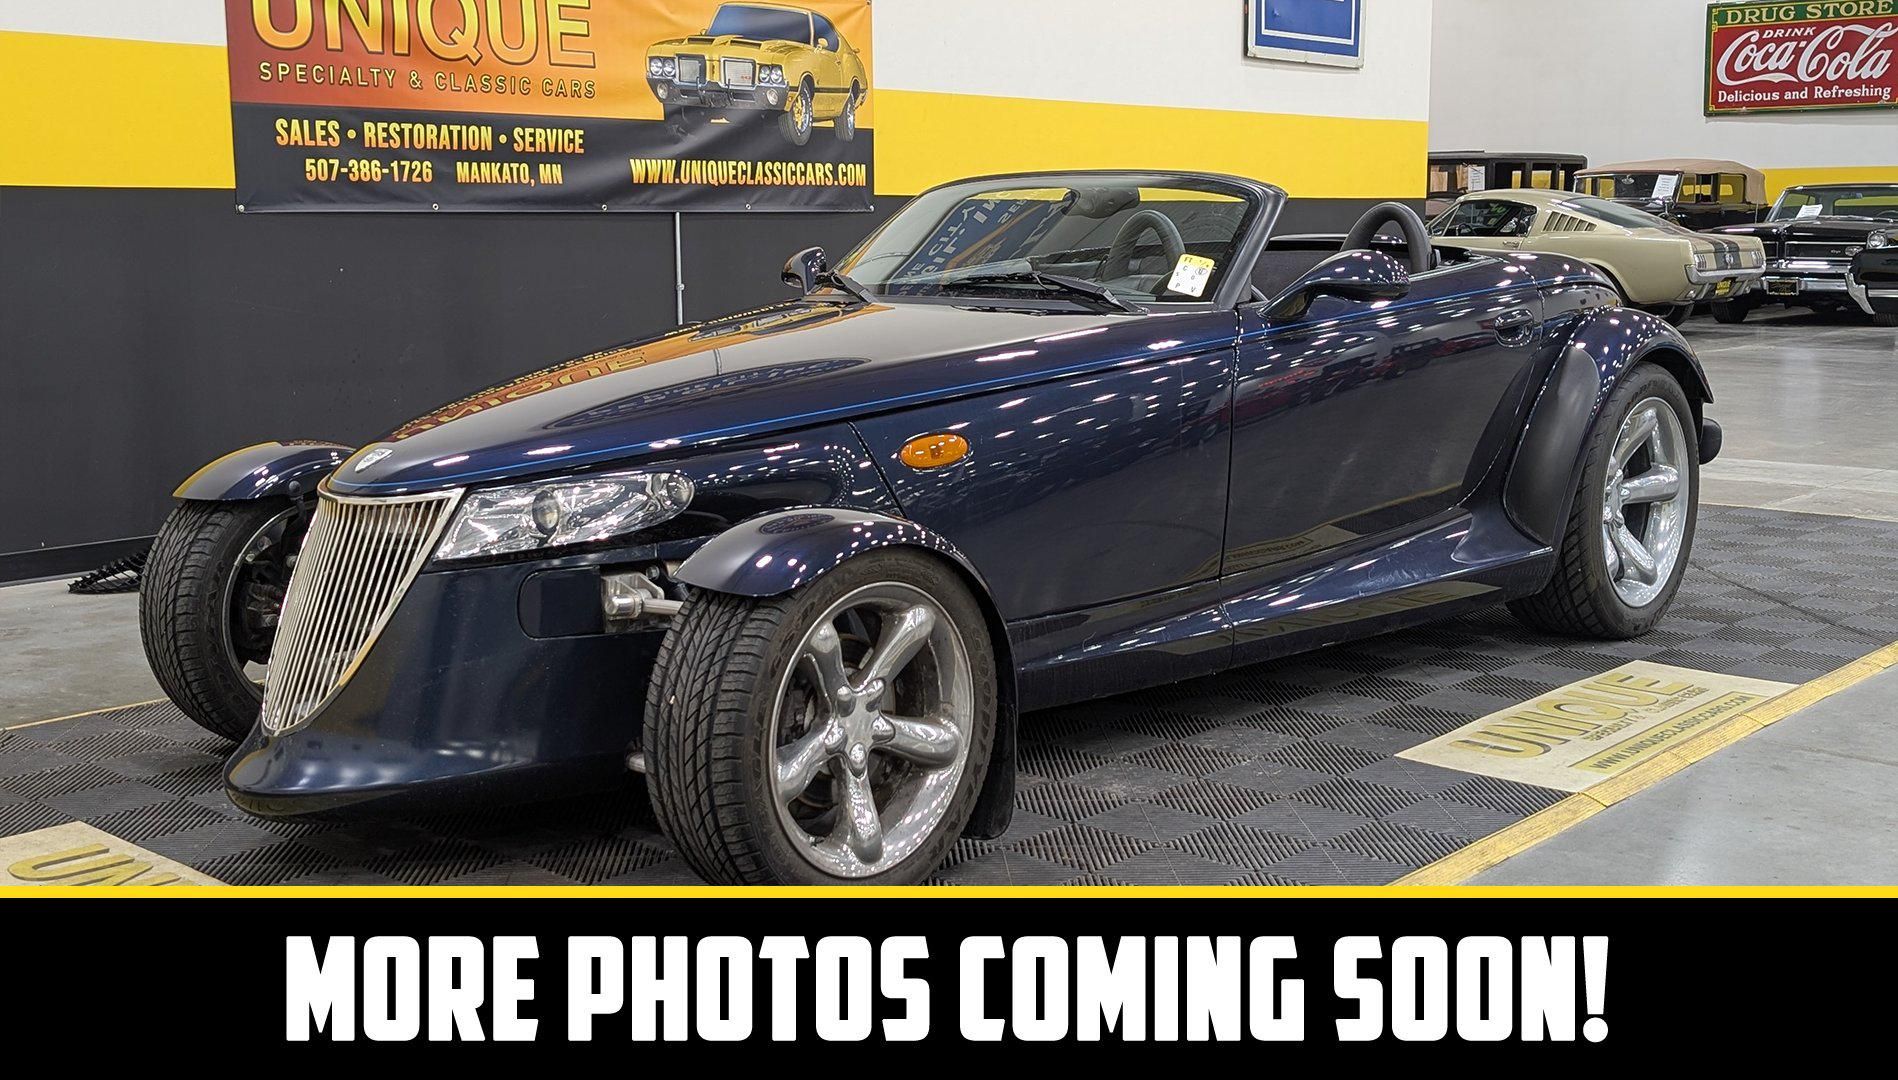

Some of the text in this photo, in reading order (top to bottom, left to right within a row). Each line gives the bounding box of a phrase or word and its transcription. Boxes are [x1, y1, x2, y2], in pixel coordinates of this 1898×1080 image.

[1726, 0, 1894, 24] DRUG STORE
[253, 0, 596, 68] UNIQUE
[1762, 26, 1818, 39] DRINK
[1716, 22, 1898, 86] Coca-Cola
[259, 61, 596, 99] SPECIALTY & CLASSIC CARS
[1717, 84, 1892, 103] Delicious and Refreshing
[275, 118, 585, 154] SALES RESTORATION SERVICE
[305, 158, 564, 188] 507-386-1726 MANKATO, MN
[629, 158, 867, 188] WWW.UNIQUECLASSICCARS.COM
[1450, 672, 1696, 759] UNIQUE
